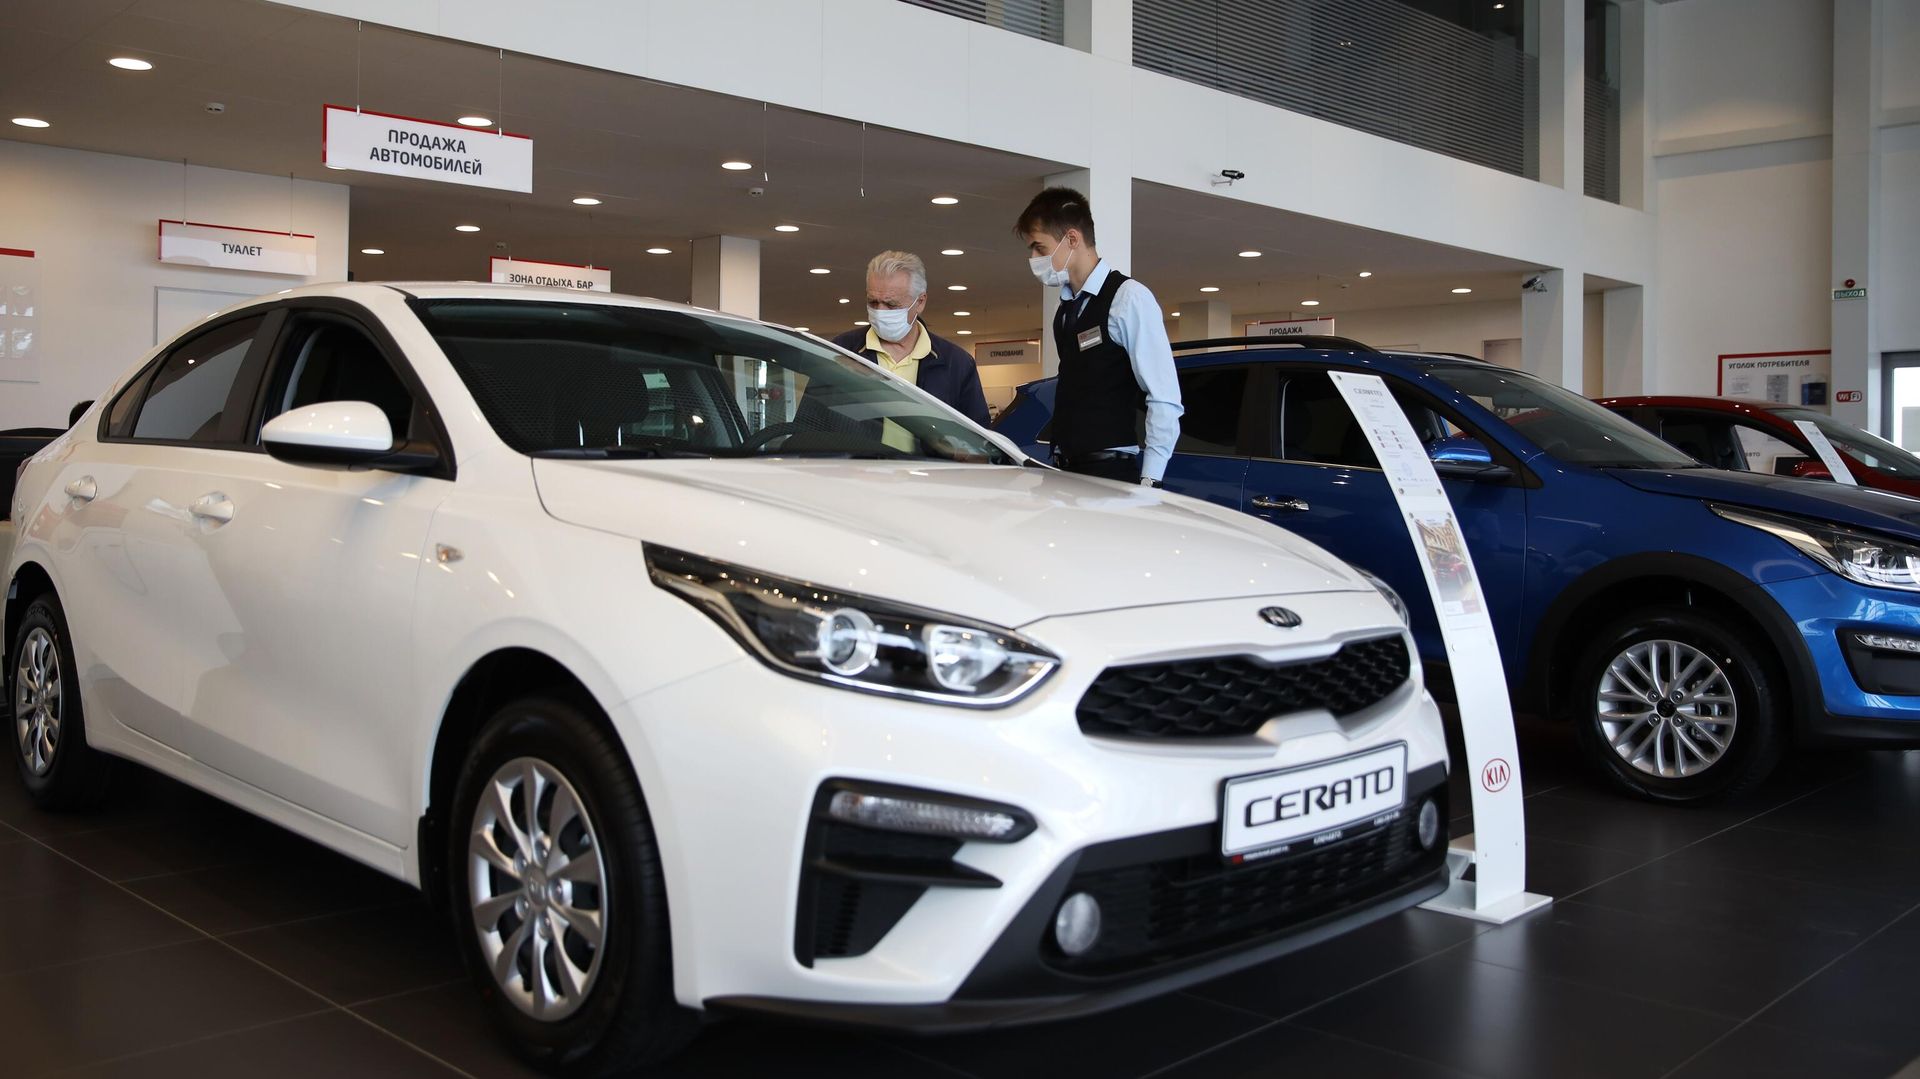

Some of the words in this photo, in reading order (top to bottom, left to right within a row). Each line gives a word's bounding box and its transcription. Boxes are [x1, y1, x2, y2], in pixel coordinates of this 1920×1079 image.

[388, 129, 467, 153] ПРОДАЖА
[369, 147, 483, 176] АВТОМОБИЛЕЙ
[222, 243, 263, 256] ТУАЛЕТ
[509, 273, 533, 284] ЗОНА
[576, 280, 594, 289] БАР
[1269, 326, 1303, 335] ПРОДАЖА
[1728, 362, 1755, 370] УГОЛОК
[1757, 360, 1810, 369] ПОТРЕБИТЕЛЯ
[1486, 765, 1507, 787] KIA
[1244, 768, 1394, 828] CERATO
